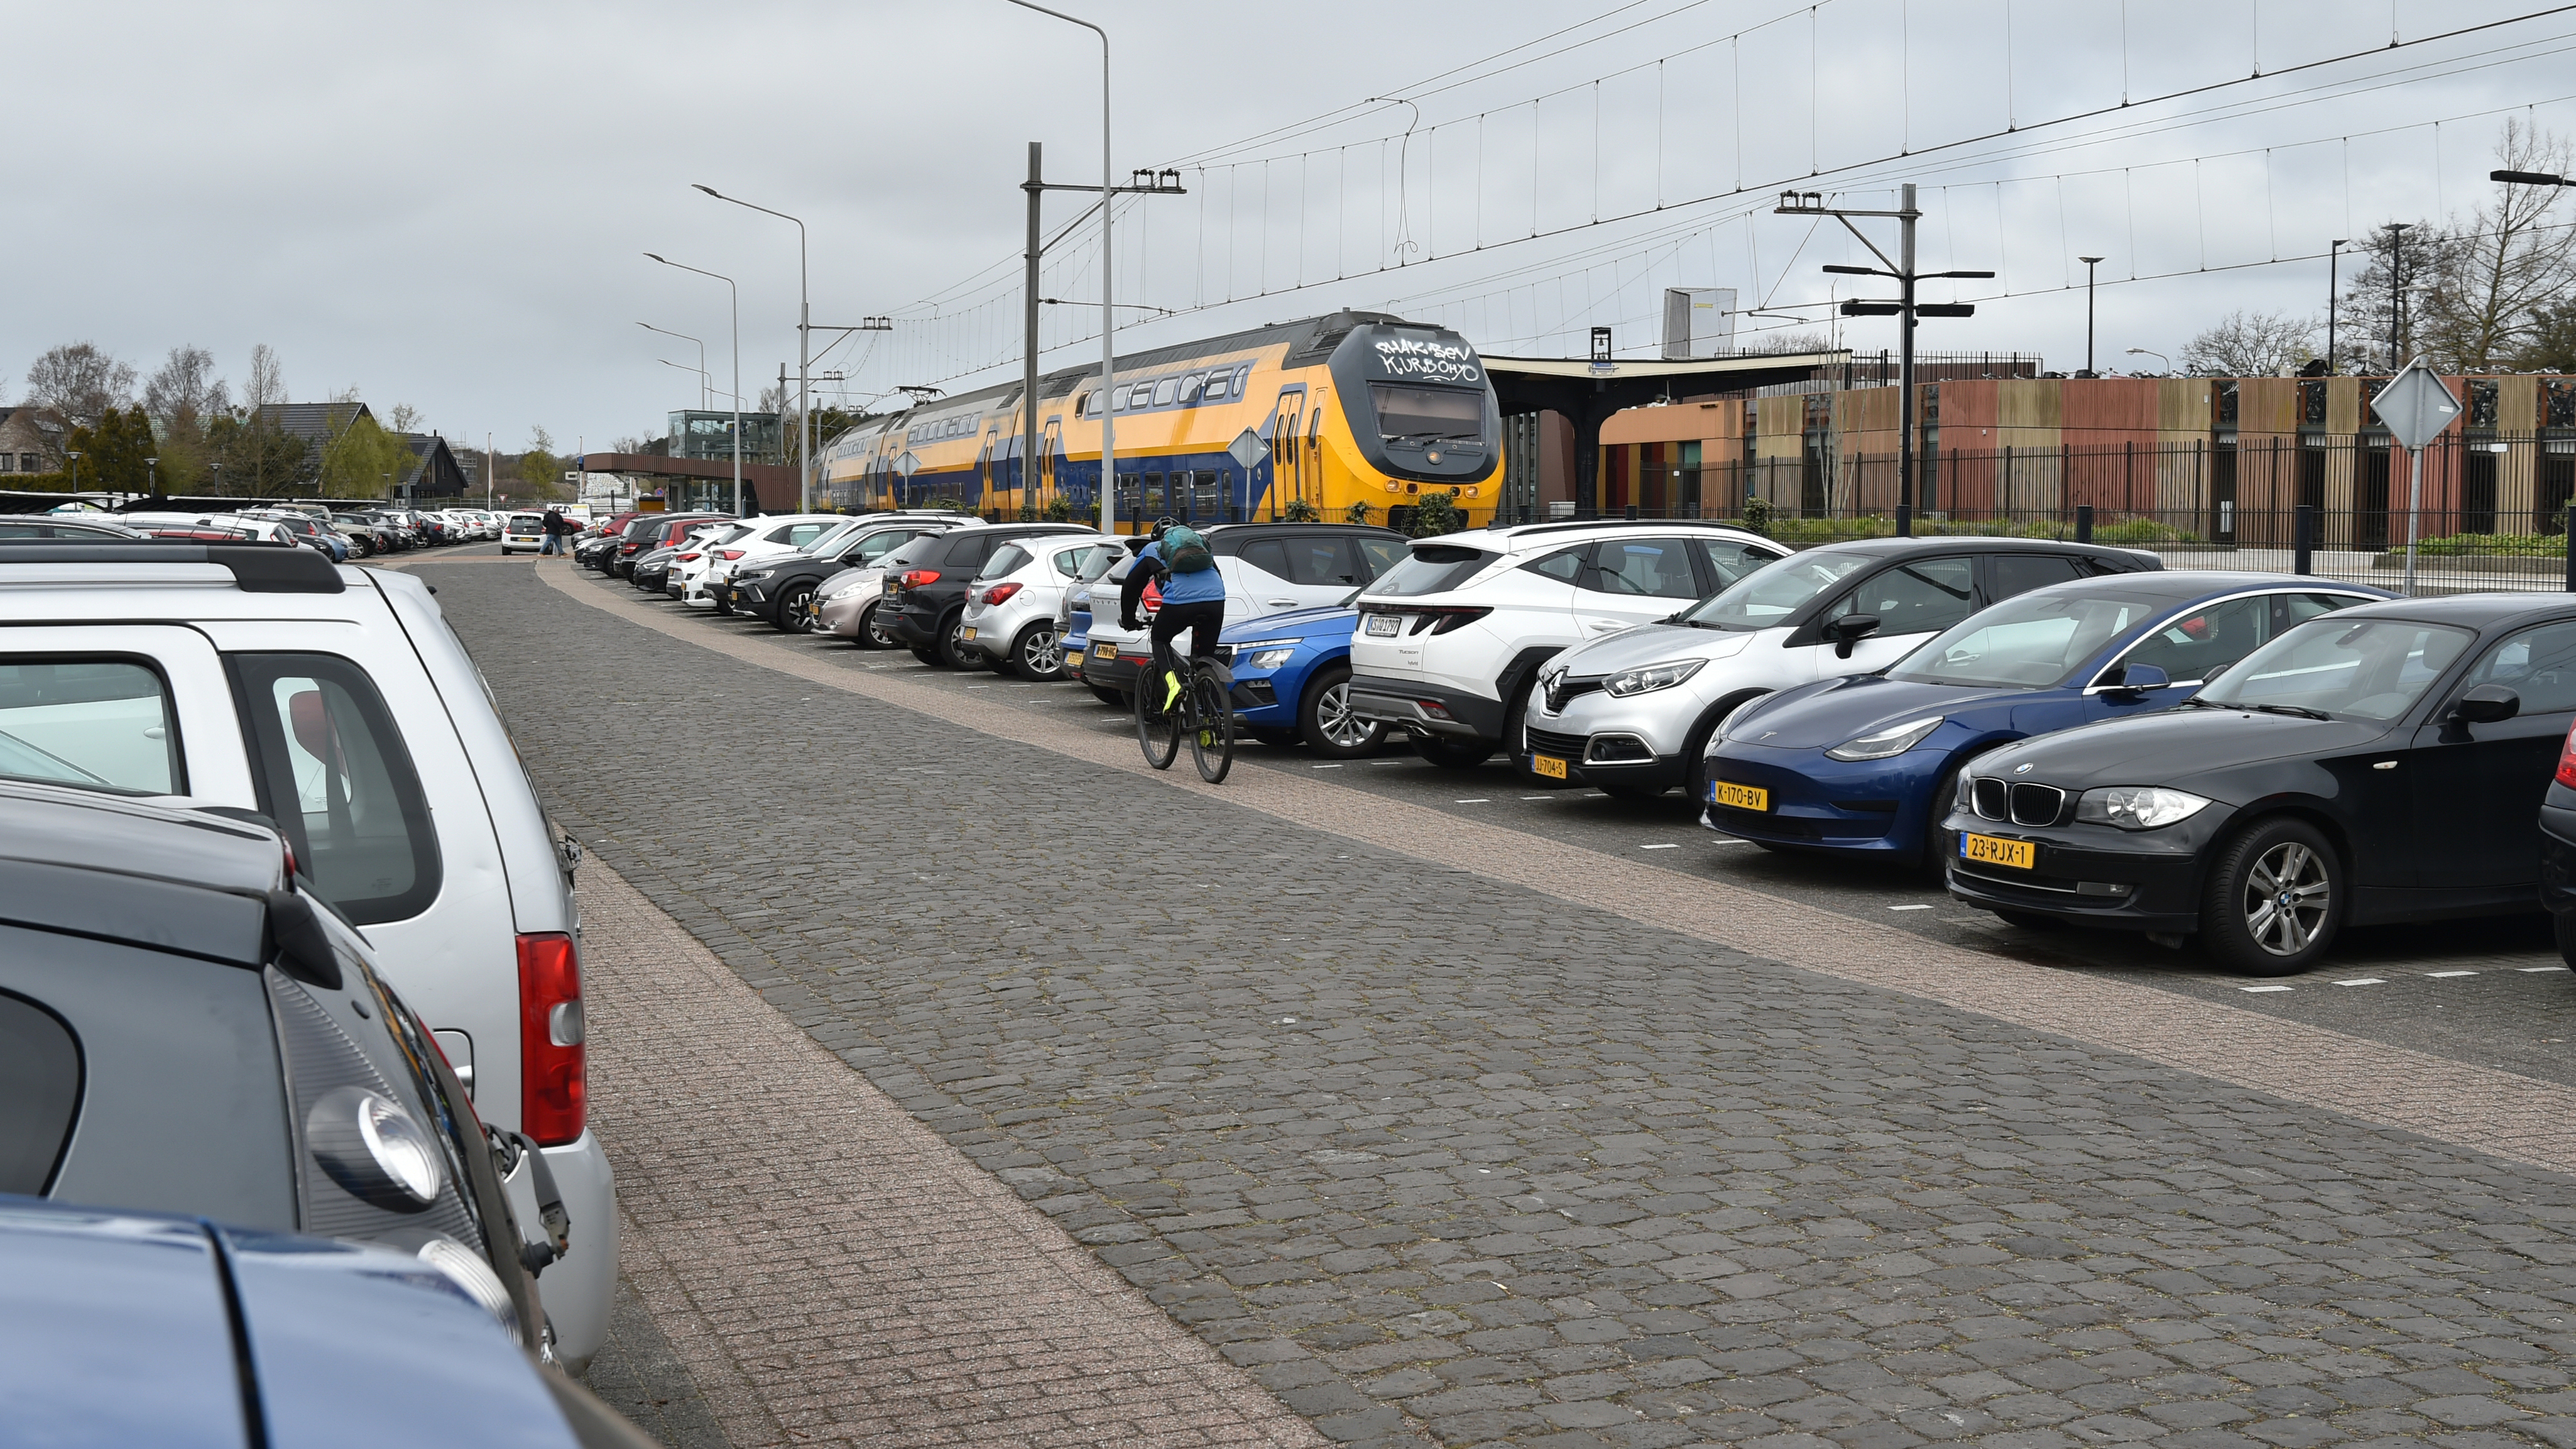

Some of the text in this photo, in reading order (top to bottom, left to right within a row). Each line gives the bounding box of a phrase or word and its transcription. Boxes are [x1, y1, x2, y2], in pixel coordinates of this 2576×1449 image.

[1117, 472, 1122, 490] 2
[1189, 470, 1194, 489] 2
[1536, 757, 1562, 775] JJ-704-S
[1718, 784, 1761, 807] K-170-BV
